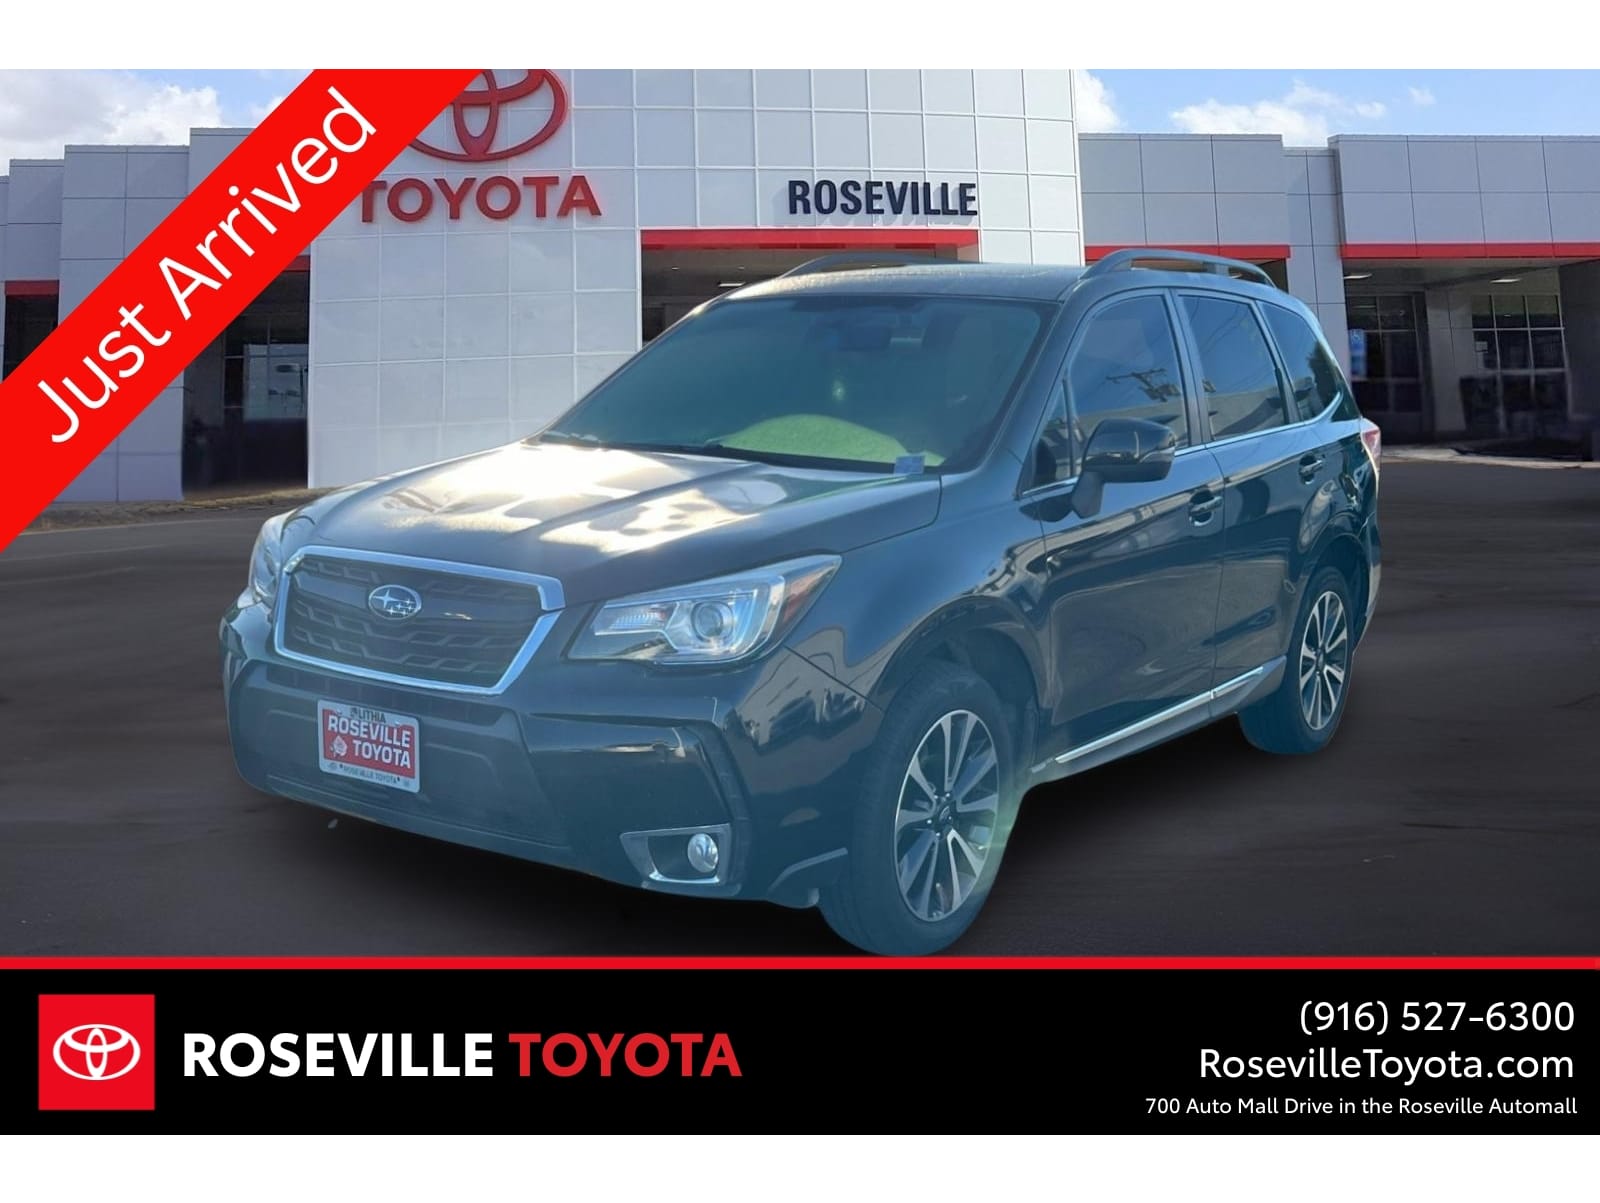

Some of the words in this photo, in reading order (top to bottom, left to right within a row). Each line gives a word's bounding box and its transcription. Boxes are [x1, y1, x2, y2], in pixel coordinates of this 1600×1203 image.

[361, 175, 602, 223] TOYOTA
[788, 179, 978, 216] ROSEVILLE
[327, 714, 411, 748] ROSEVILLE
[359, 708, 387, 723] LITHIA
[352, 739, 411, 769] TOYOTA
